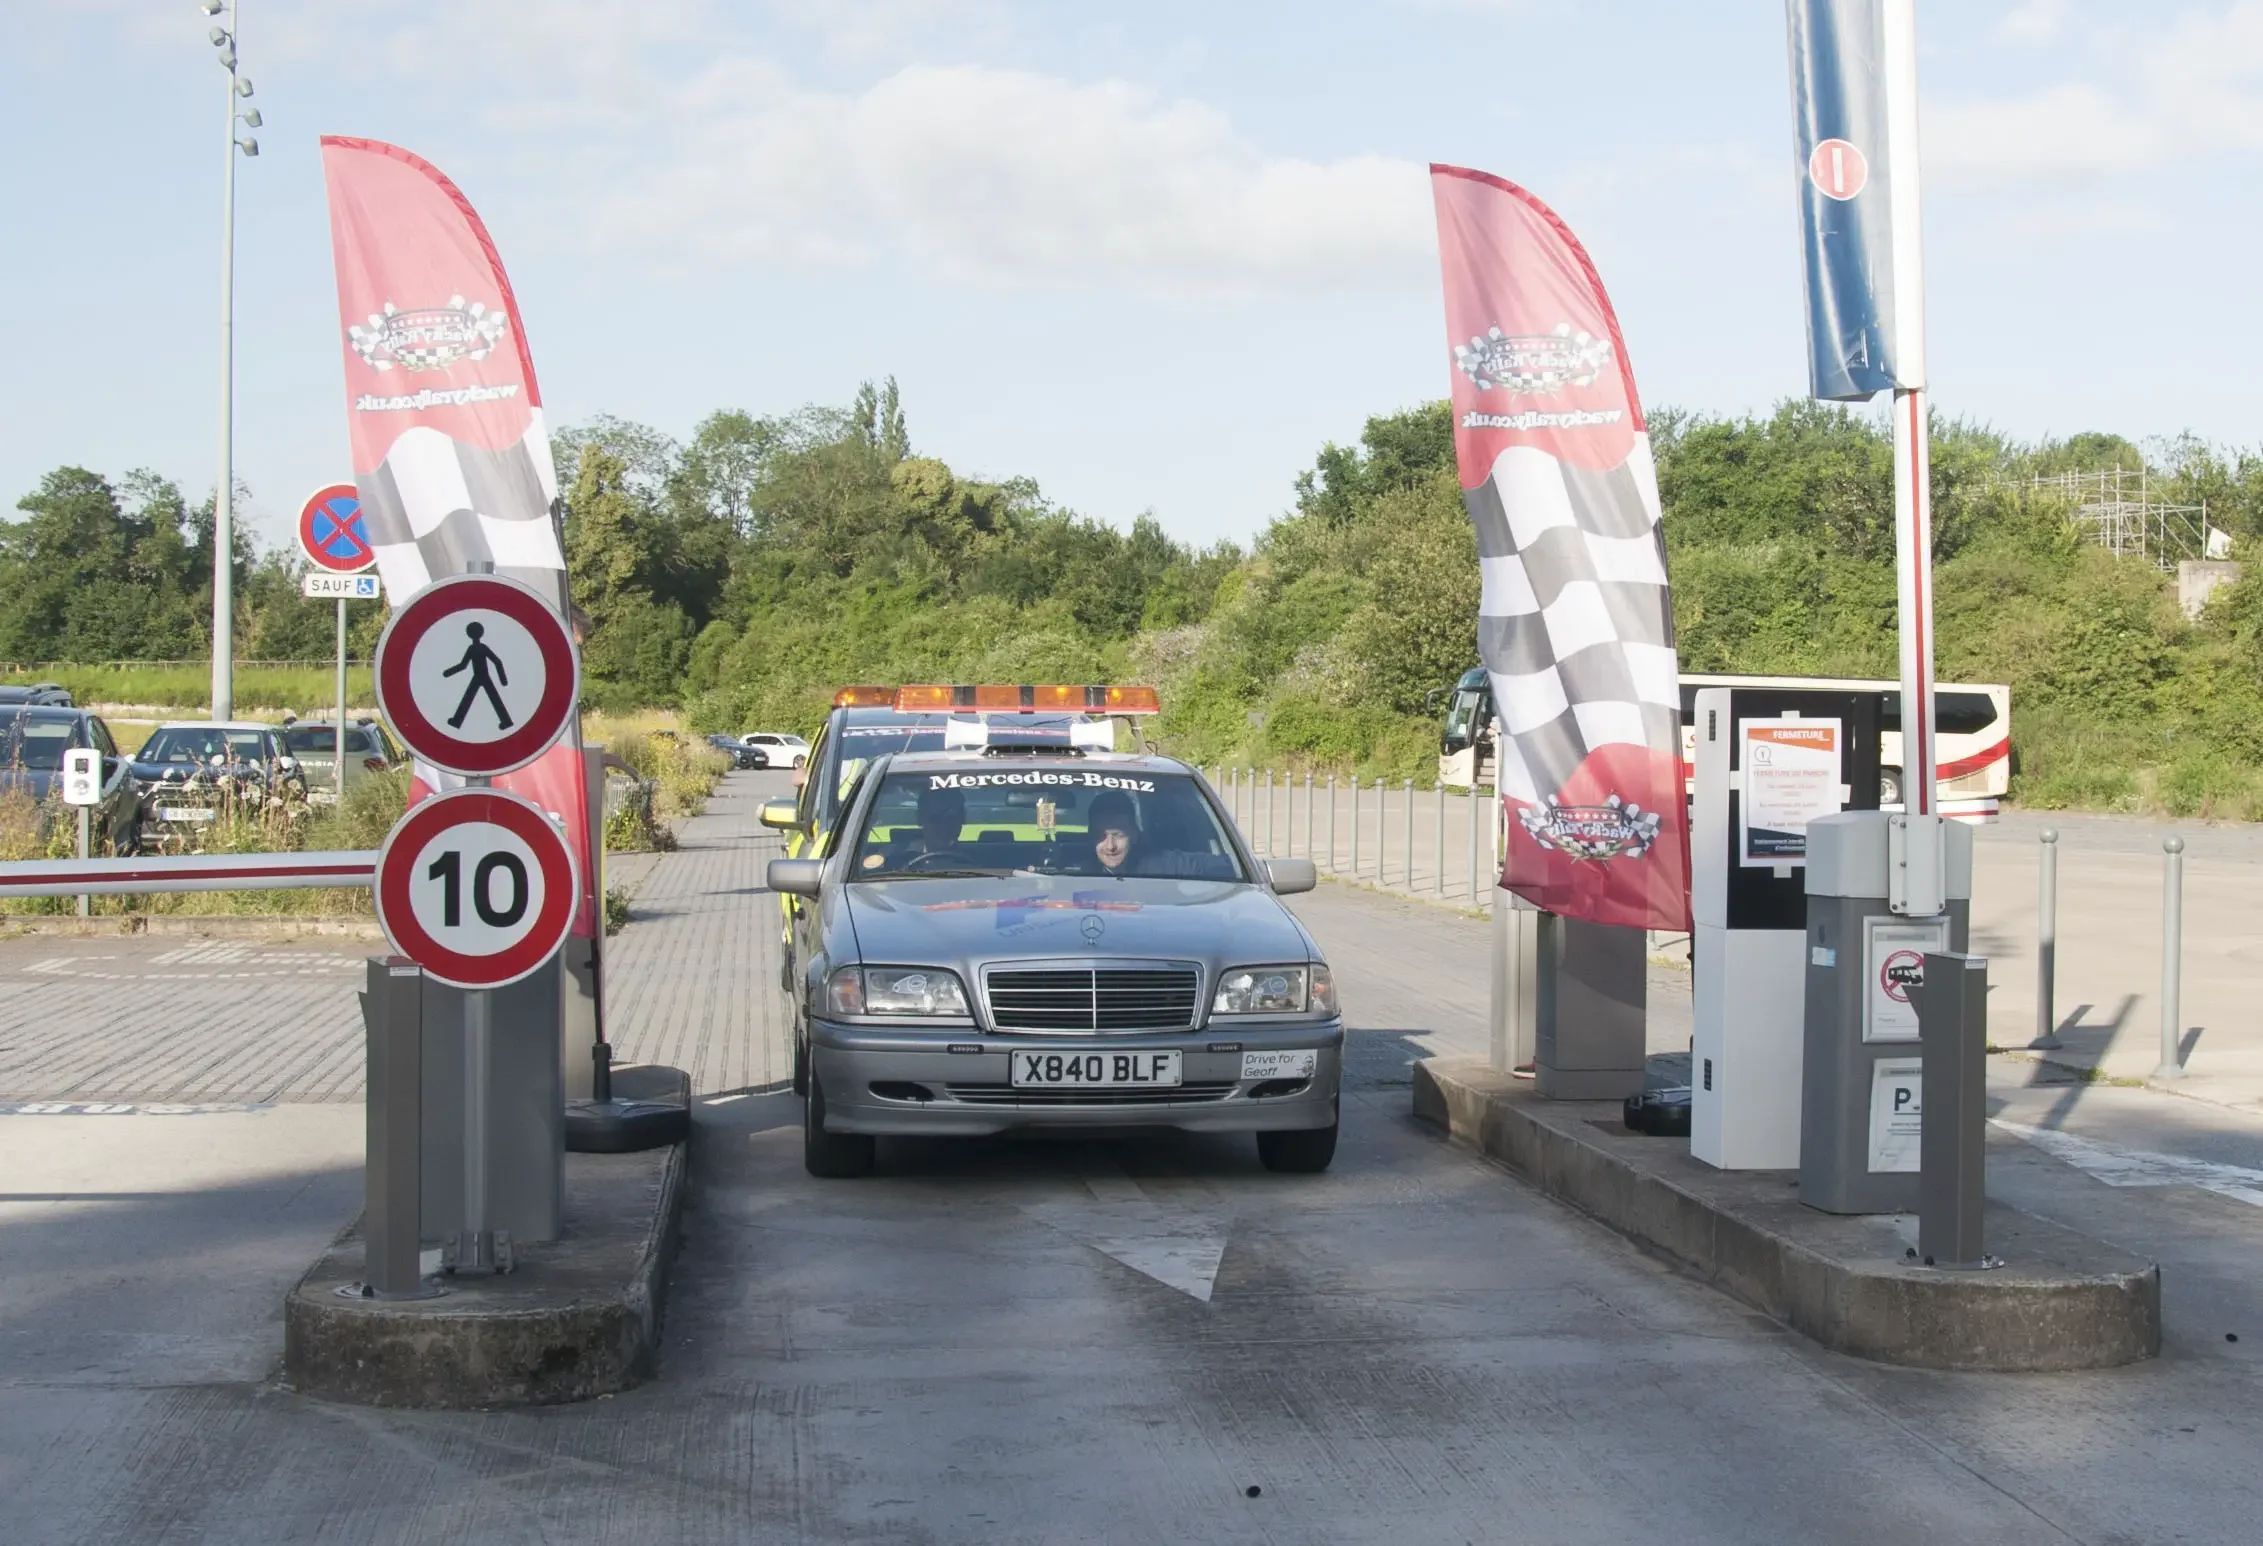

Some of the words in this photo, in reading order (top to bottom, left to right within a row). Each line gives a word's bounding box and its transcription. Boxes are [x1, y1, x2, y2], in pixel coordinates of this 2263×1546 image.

[312, 579, 352, 592] SAUF
[1772, 730, 1824, 740] FERMETURE
[929, 770, 1155, 792] Mercedes-Benz
[428, 850, 529, 927] 10
[1246, 1054, 1276, 1064] Drive
[1278, 1054, 1296, 1064] for
[1025, 1055, 1102, 1082] X840
[1113, 1055, 1169, 1082] BLF
[1244, 1066, 1278, 1077] Geoff
[1894, 1087, 1912, 1112] P
